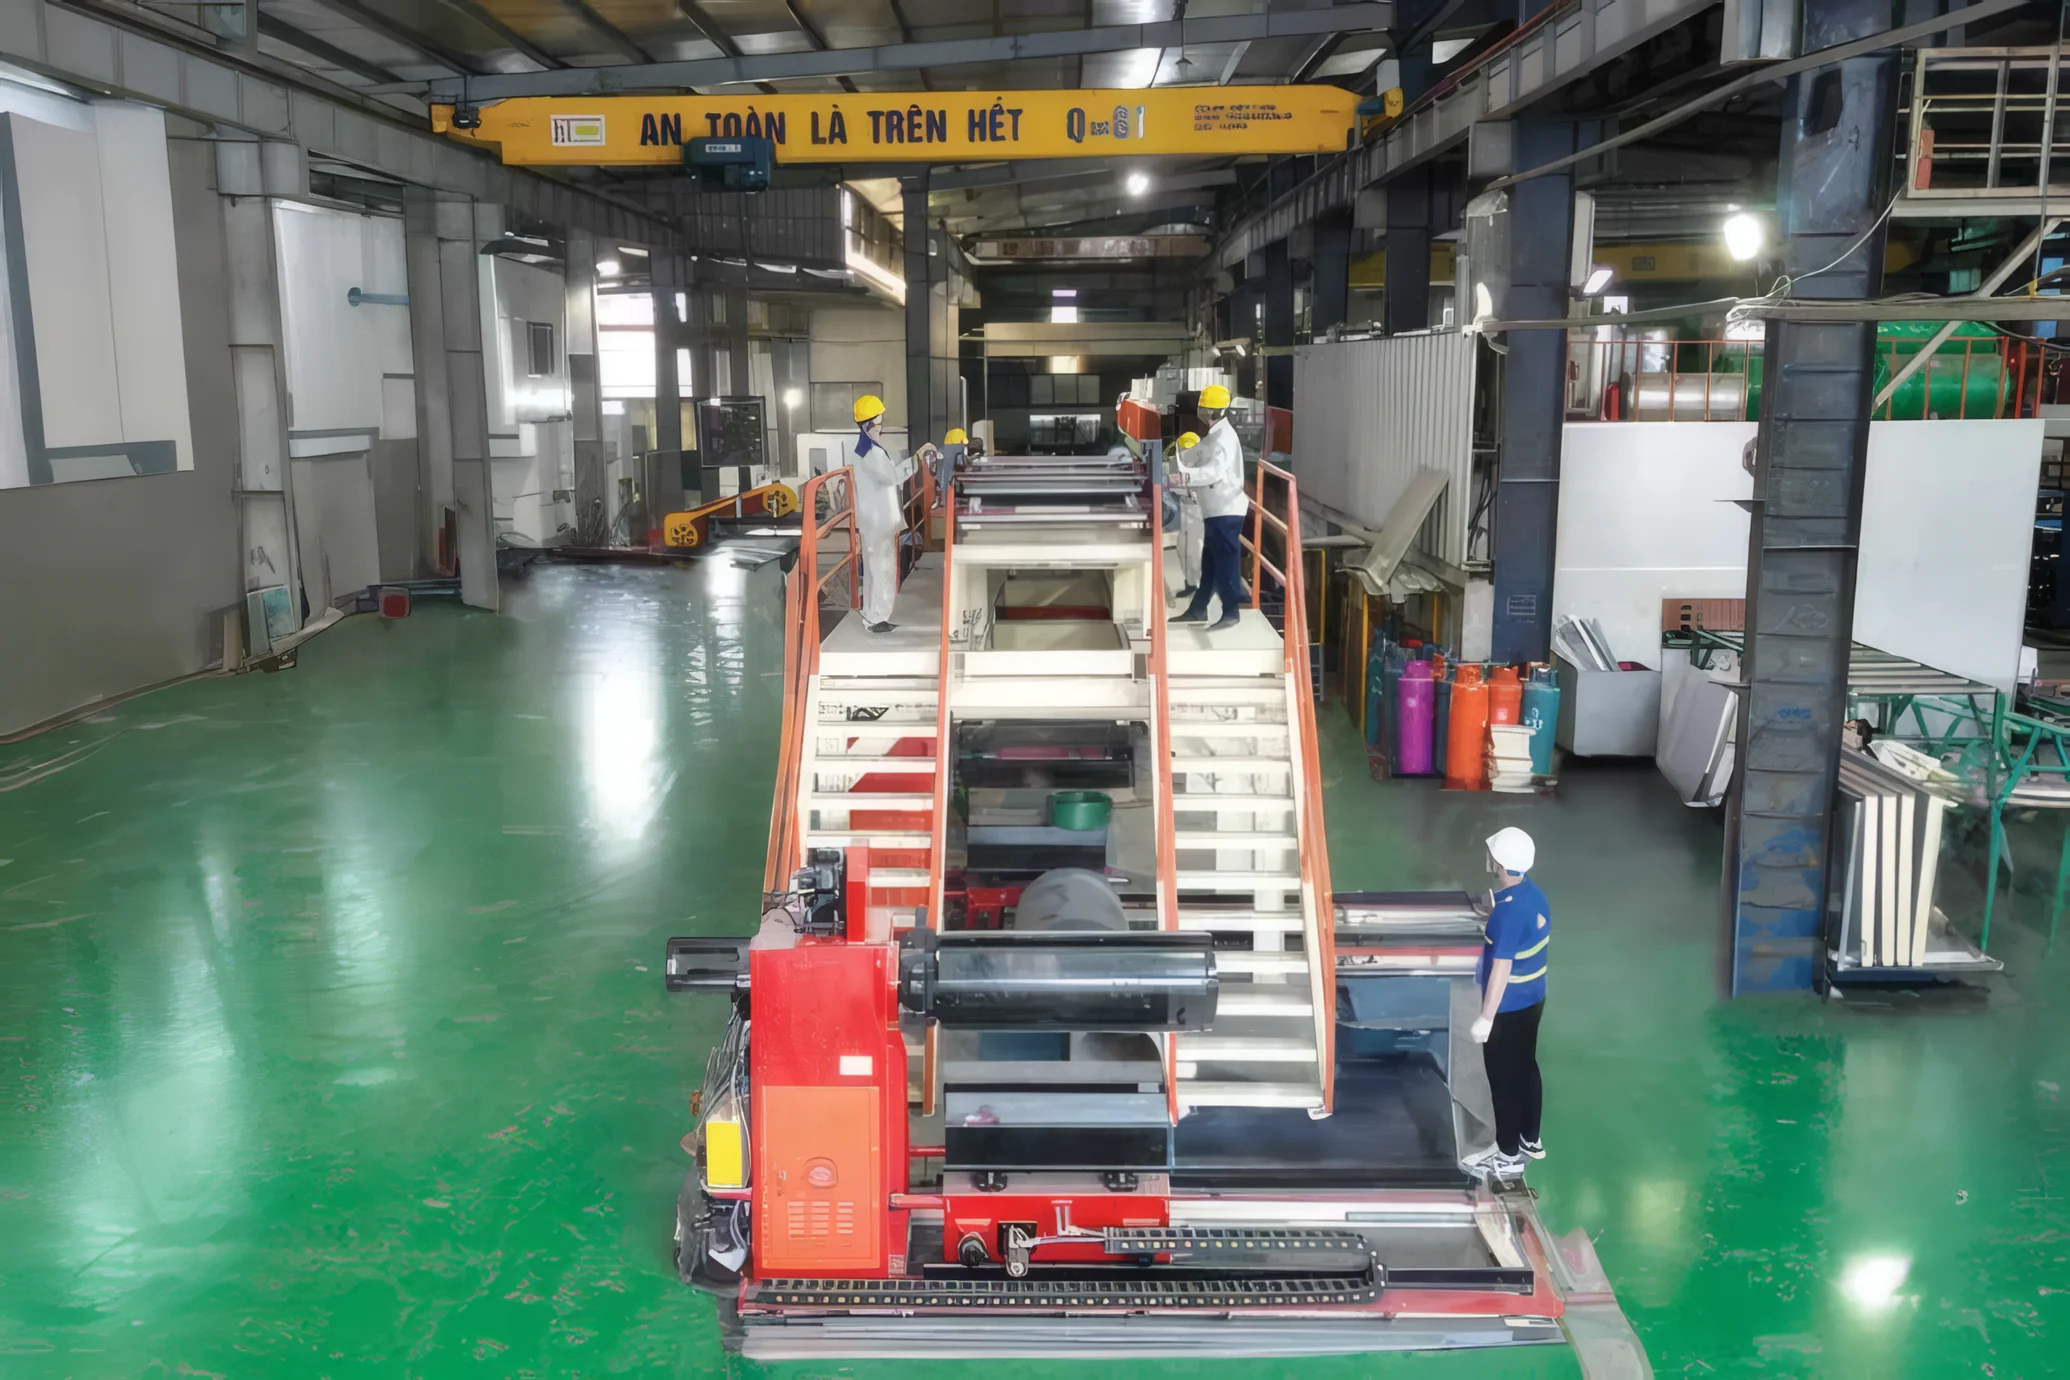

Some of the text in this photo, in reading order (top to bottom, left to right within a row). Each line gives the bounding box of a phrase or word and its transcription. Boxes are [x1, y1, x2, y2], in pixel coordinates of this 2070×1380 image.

[640, 113, 682, 146] AN
[705, 105, 786, 145] TOÀN
[811, 104, 847, 144] LÀ
[867, 104, 946, 144] TRÊN
